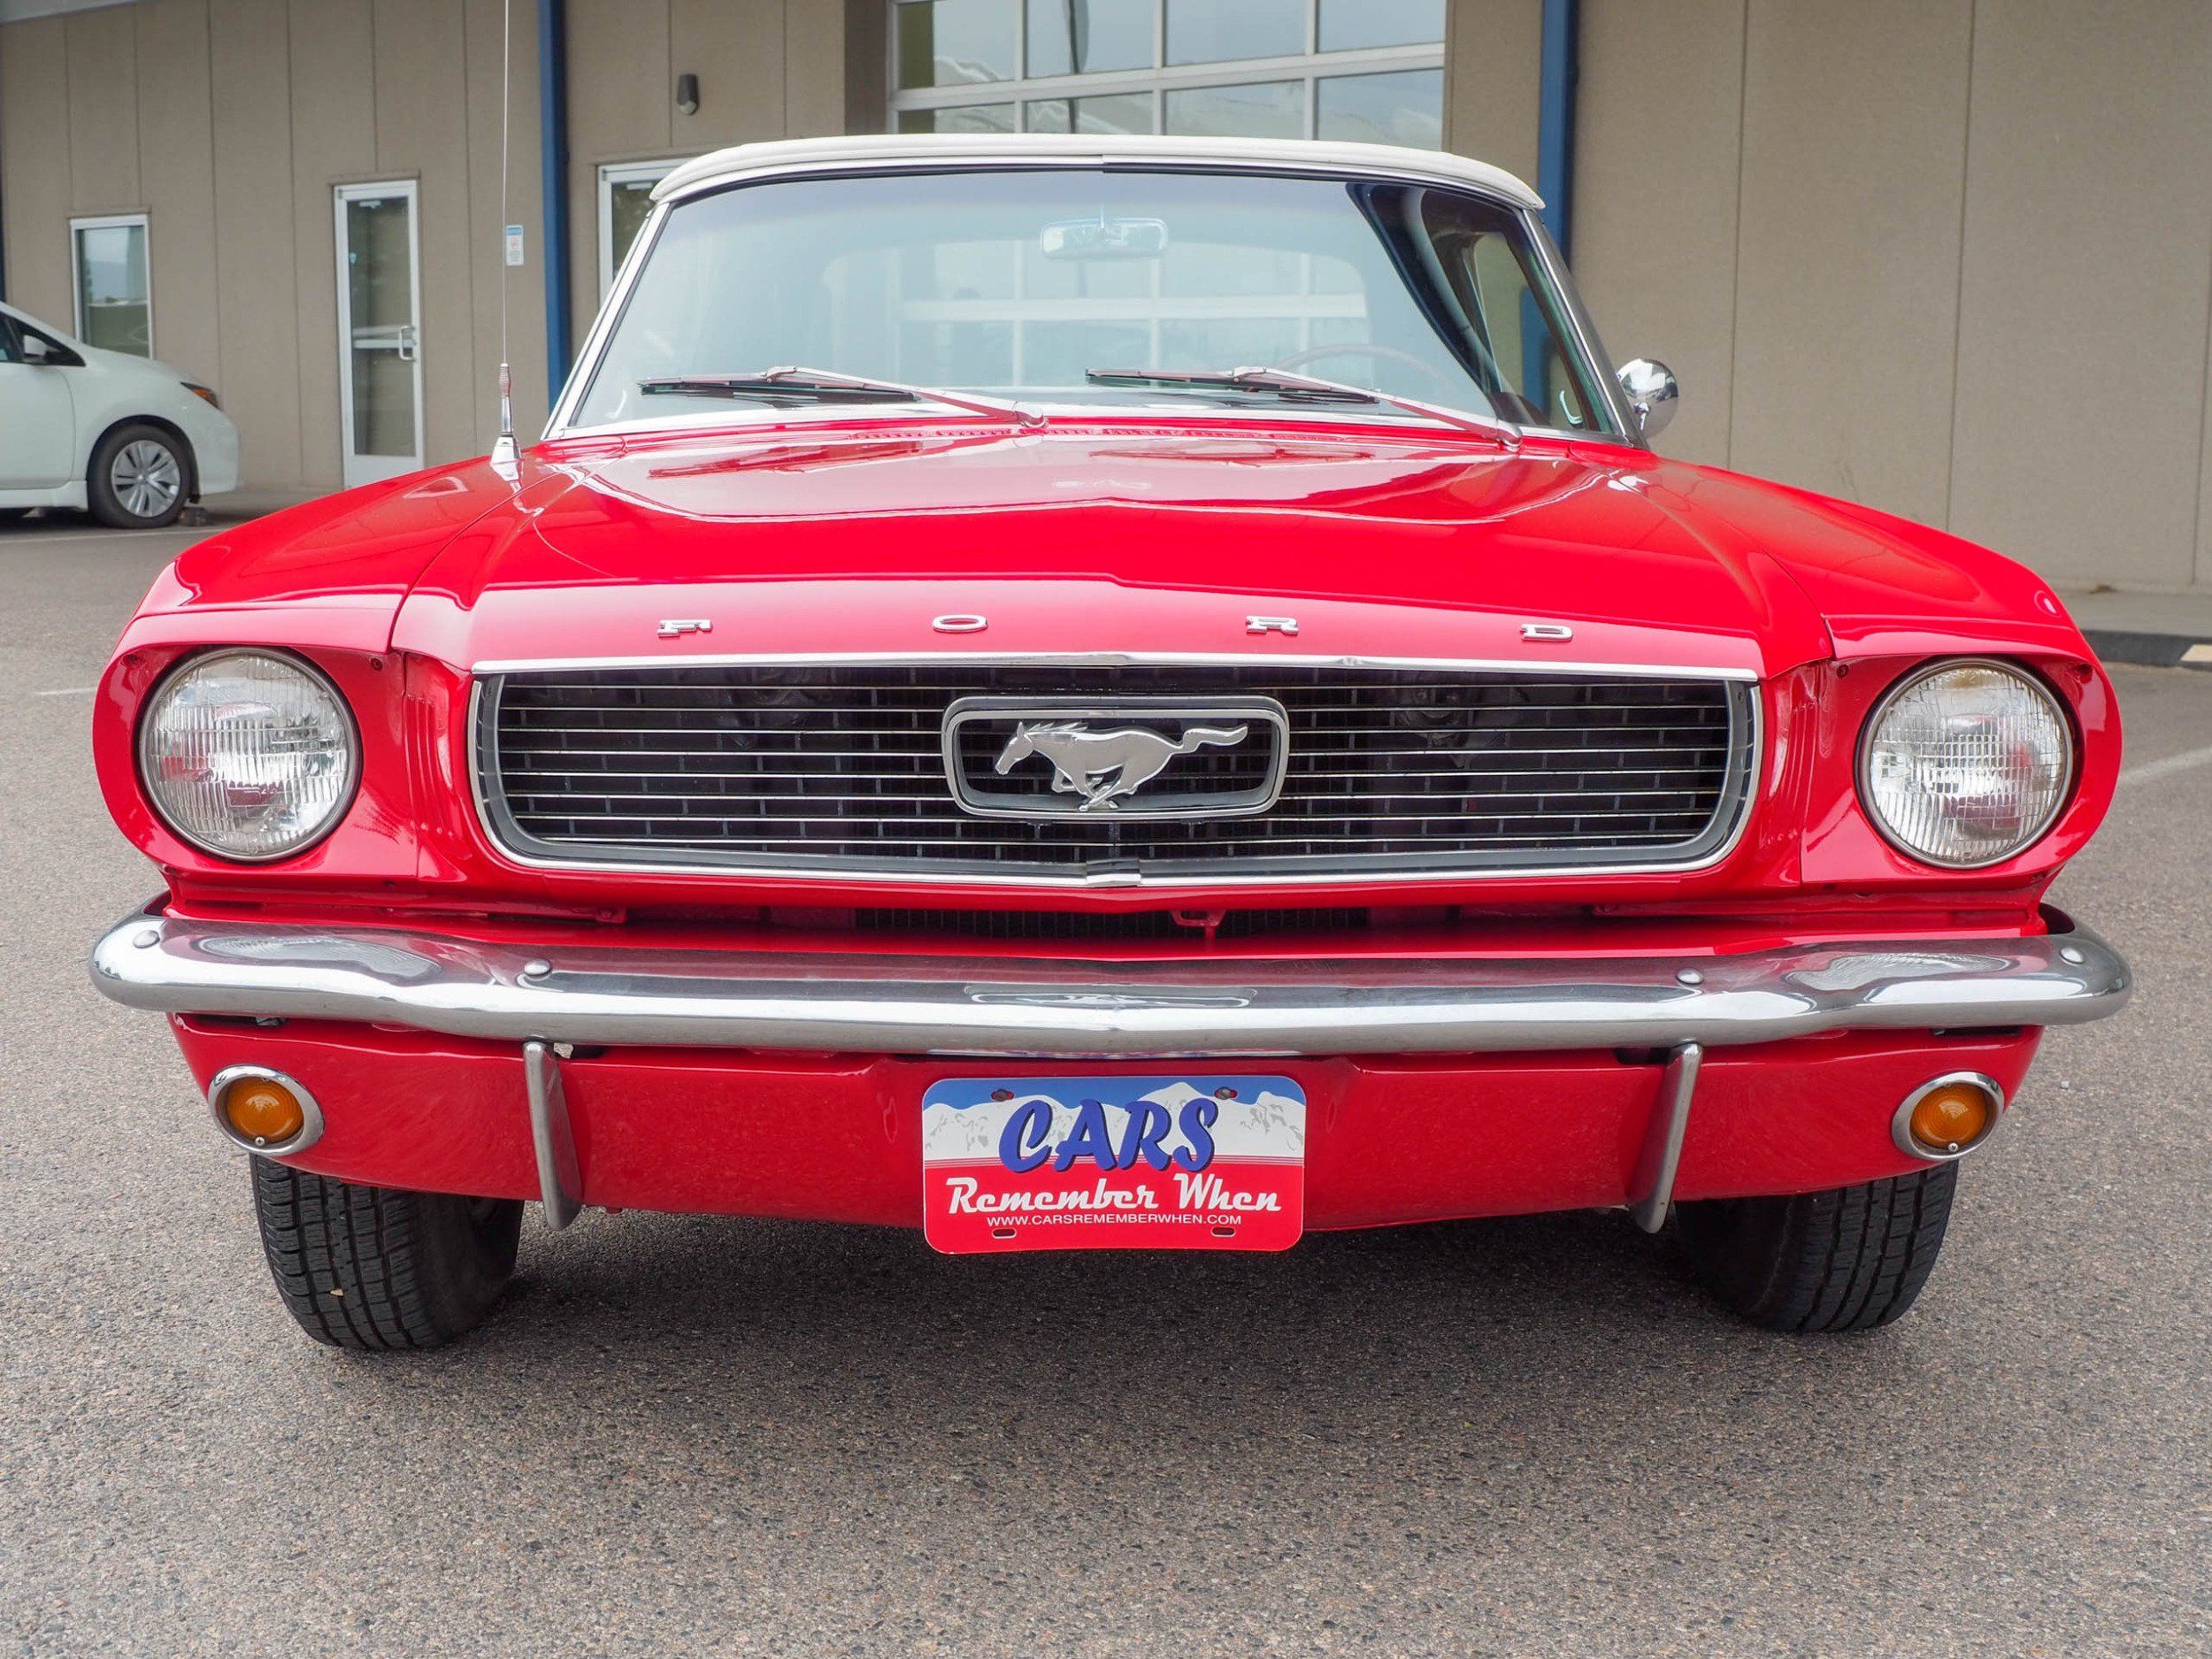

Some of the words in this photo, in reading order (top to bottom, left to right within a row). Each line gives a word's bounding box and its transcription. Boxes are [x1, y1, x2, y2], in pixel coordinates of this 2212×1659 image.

[657, 614, 1573, 641] FORD
[998, 1097, 1219, 1173] CARS
[945, 1176, 1159, 1215] Remember
[1173, 1173, 1281, 1212] When
[987, 1213, 1242, 1227] WWW.CARSREMEMBERWHEN.COM
